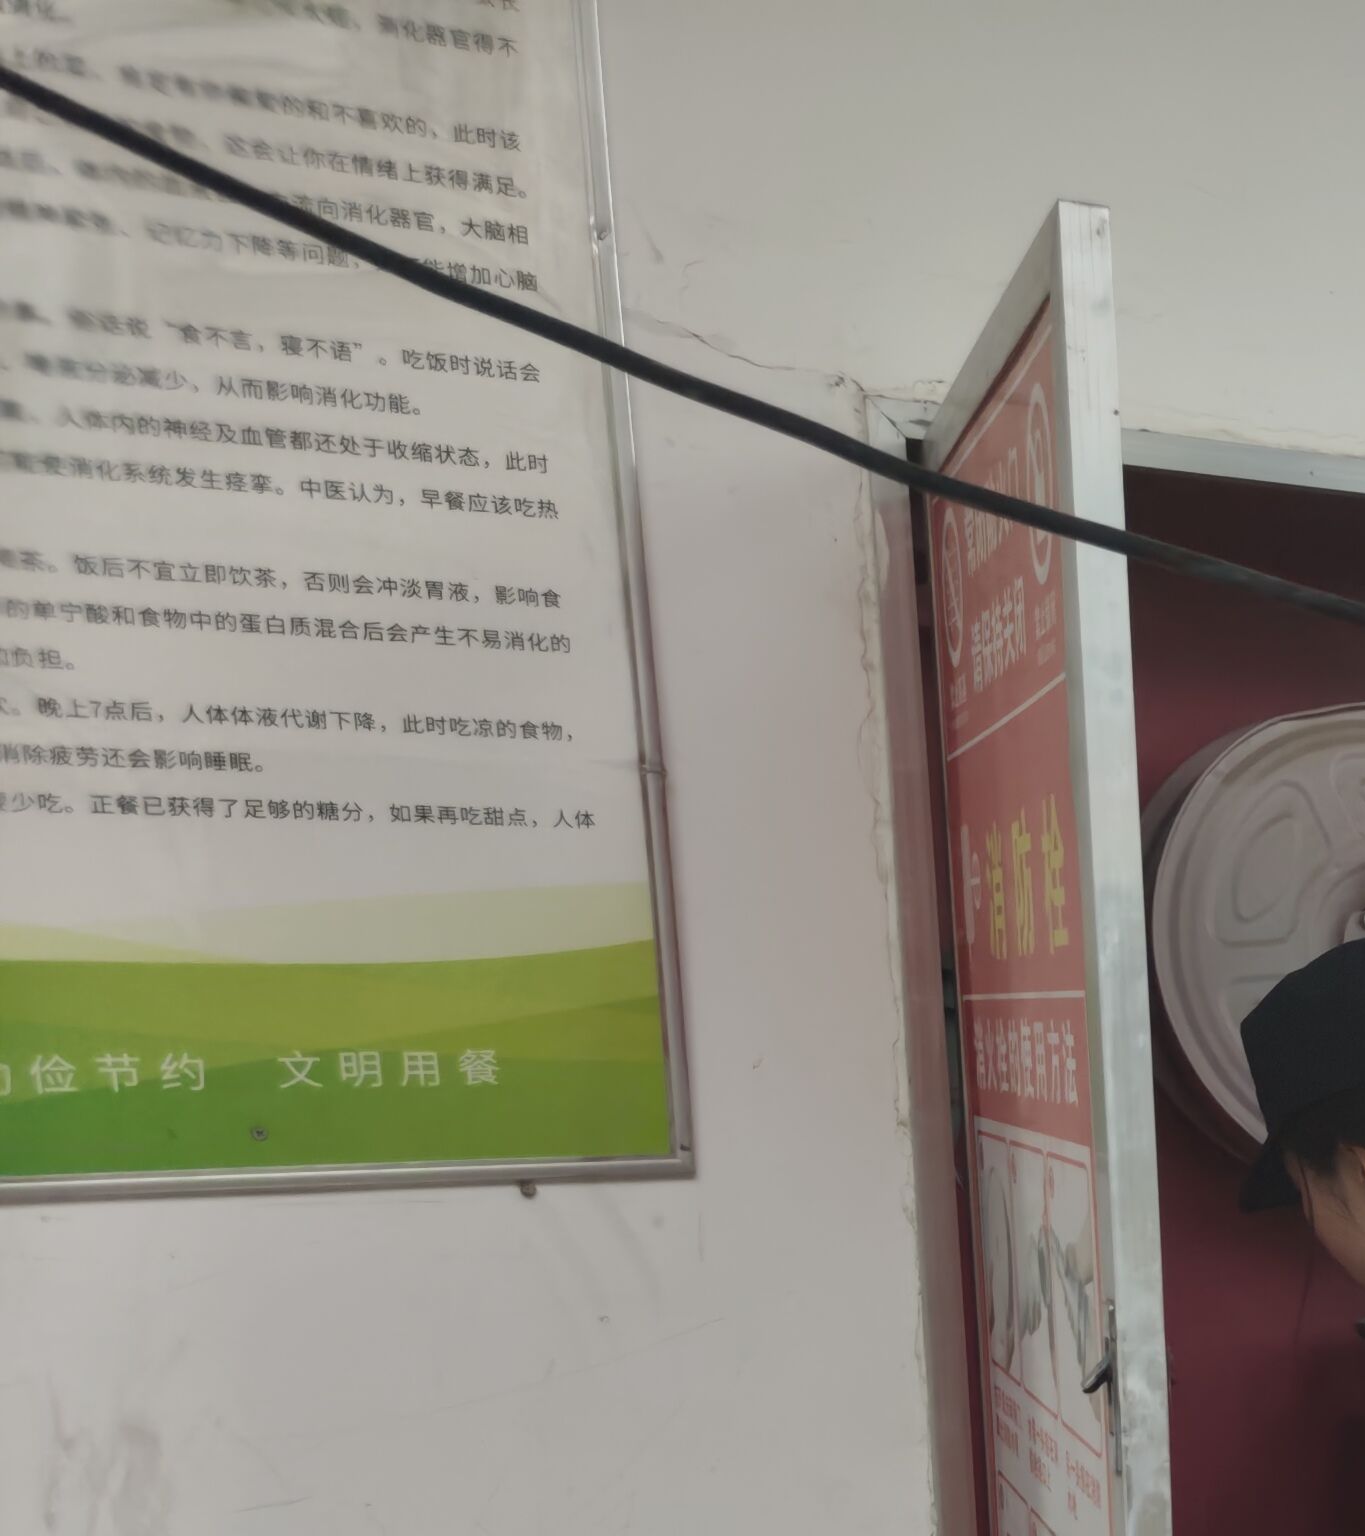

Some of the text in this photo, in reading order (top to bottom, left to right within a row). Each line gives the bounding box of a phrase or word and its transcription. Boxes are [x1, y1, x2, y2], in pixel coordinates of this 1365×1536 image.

[0, 697, 575, 743] 。晚上7点后，人体体液代谢下降，此时吃凉的食物，
[0, 1049, 501, 1095] 俭节约 文明用餐
